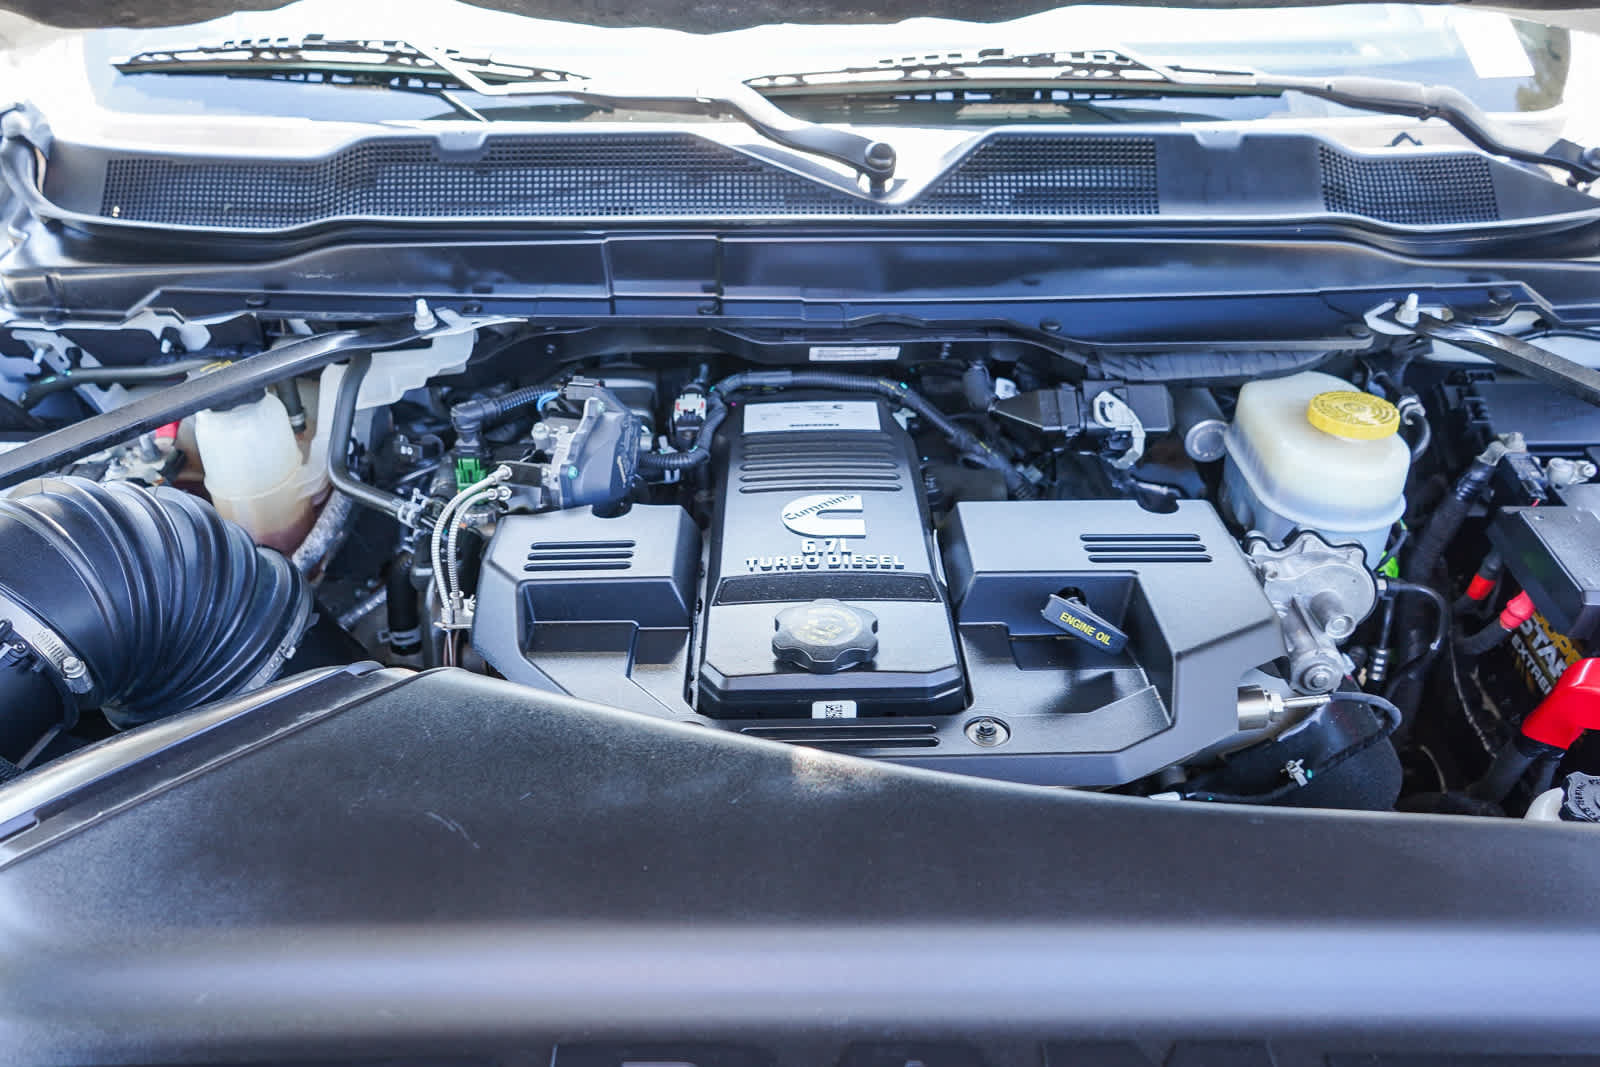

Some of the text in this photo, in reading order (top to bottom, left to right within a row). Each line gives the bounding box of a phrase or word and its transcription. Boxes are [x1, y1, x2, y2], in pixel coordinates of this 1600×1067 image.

[801, 538, 852, 555] 6.7L
[746, 554, 904, 572] TURBO DIESEL
[1060, 612, 1111, 646] ENGINE OIL
